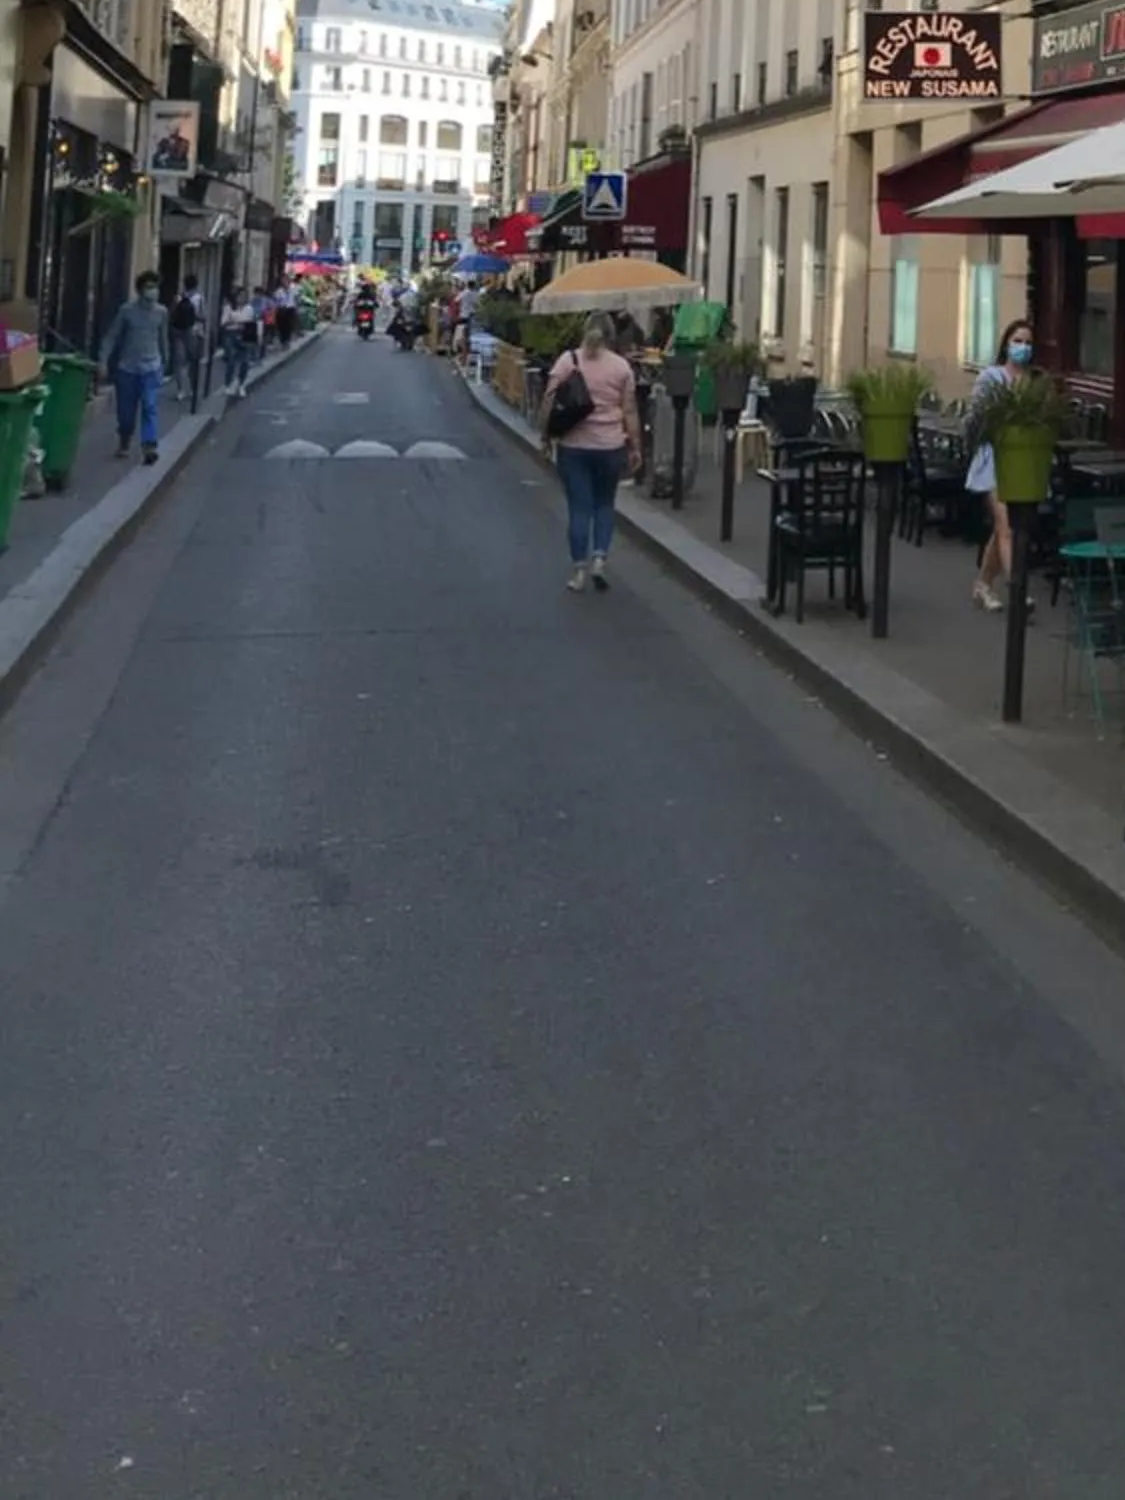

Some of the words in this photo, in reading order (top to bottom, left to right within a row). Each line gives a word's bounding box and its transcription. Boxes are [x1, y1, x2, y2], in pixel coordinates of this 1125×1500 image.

[868, 13, 998, 75] RESTAURANT
[867, 80, 911, 96] NEW
[922, 80, 998, 96] SUSAMA
